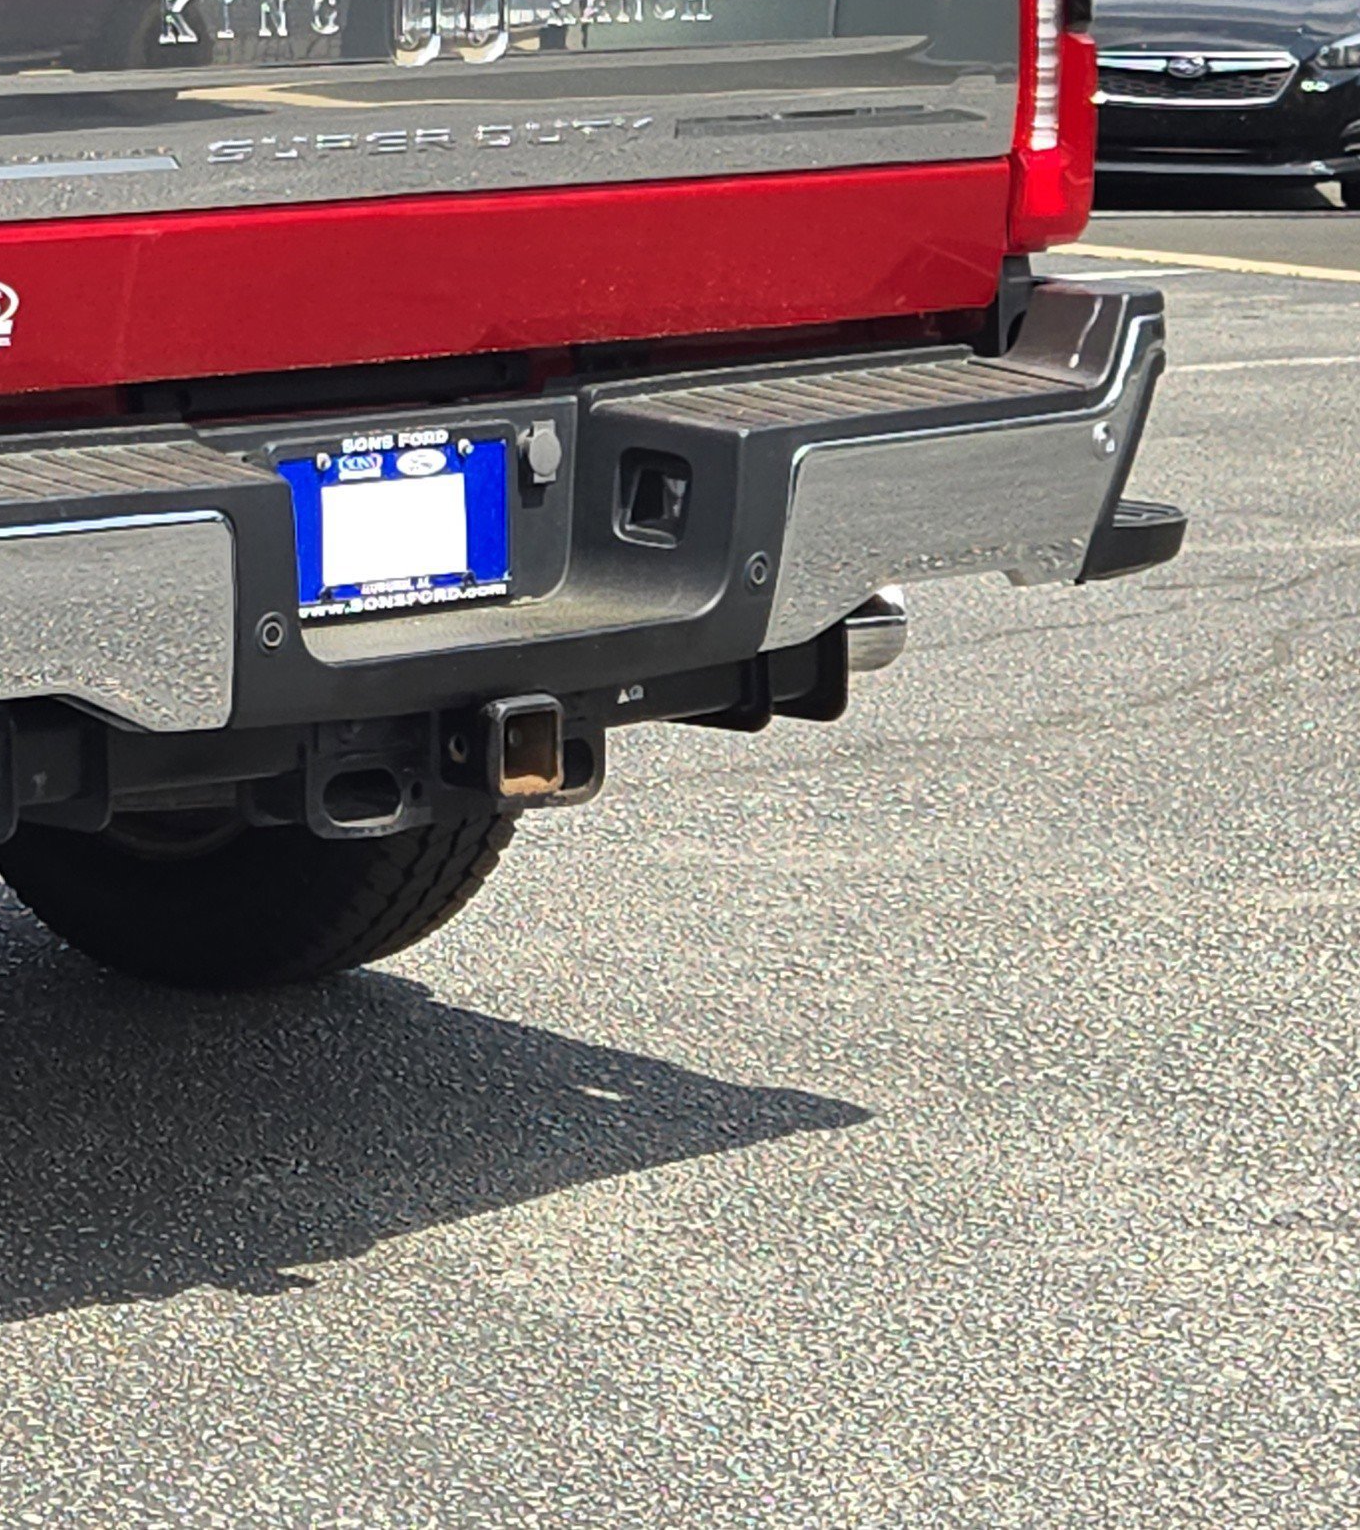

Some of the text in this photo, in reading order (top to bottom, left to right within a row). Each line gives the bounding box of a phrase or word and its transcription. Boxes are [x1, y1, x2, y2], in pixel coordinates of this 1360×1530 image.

[206, 124, 456, 164] SUPER
[342, 430, 449, 453] SONS FORD
